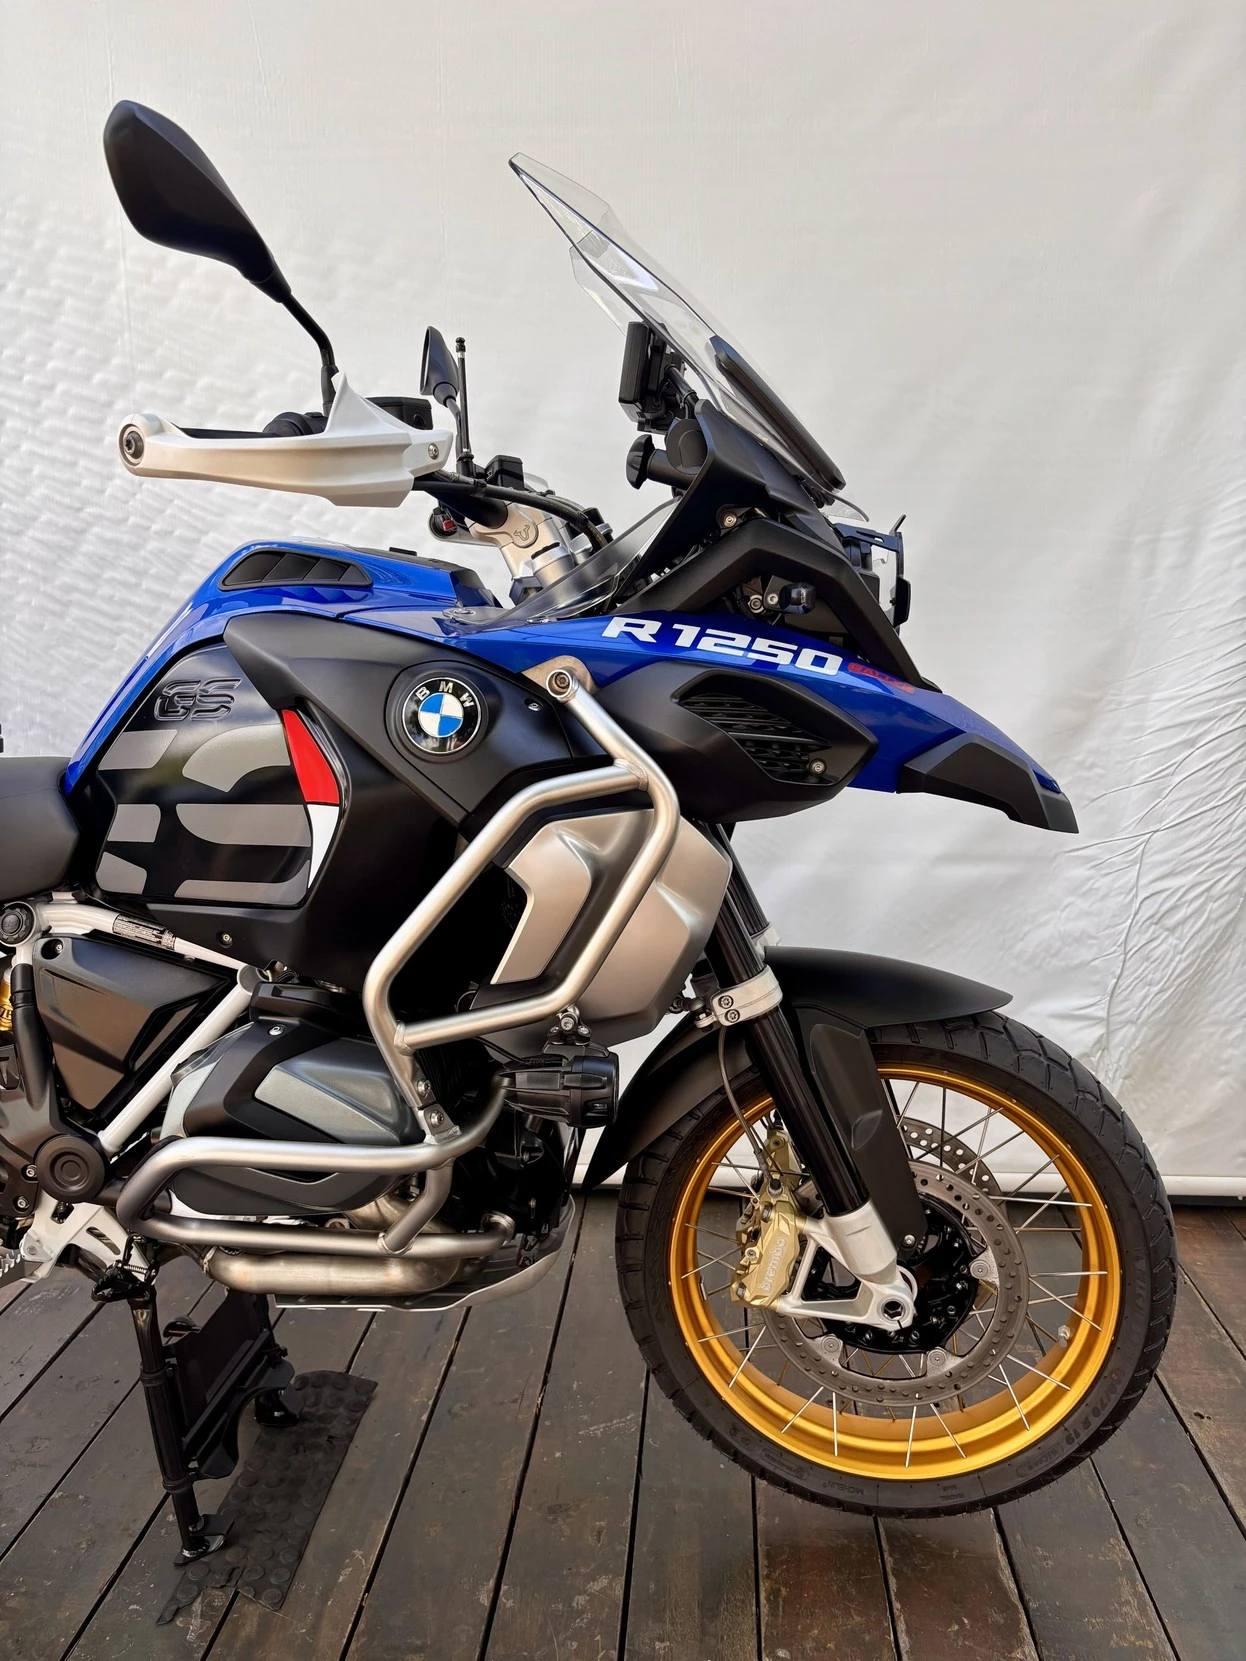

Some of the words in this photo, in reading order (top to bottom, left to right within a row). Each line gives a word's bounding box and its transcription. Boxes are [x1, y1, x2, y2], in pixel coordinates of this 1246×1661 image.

[602, 617, 662, 643] R
[671, 623, 843, 676] 1250
[154, 678, 241, 722] GS
[415, 680, 475, 708] BMW
[757, 1238, 787, 1292] brembo
